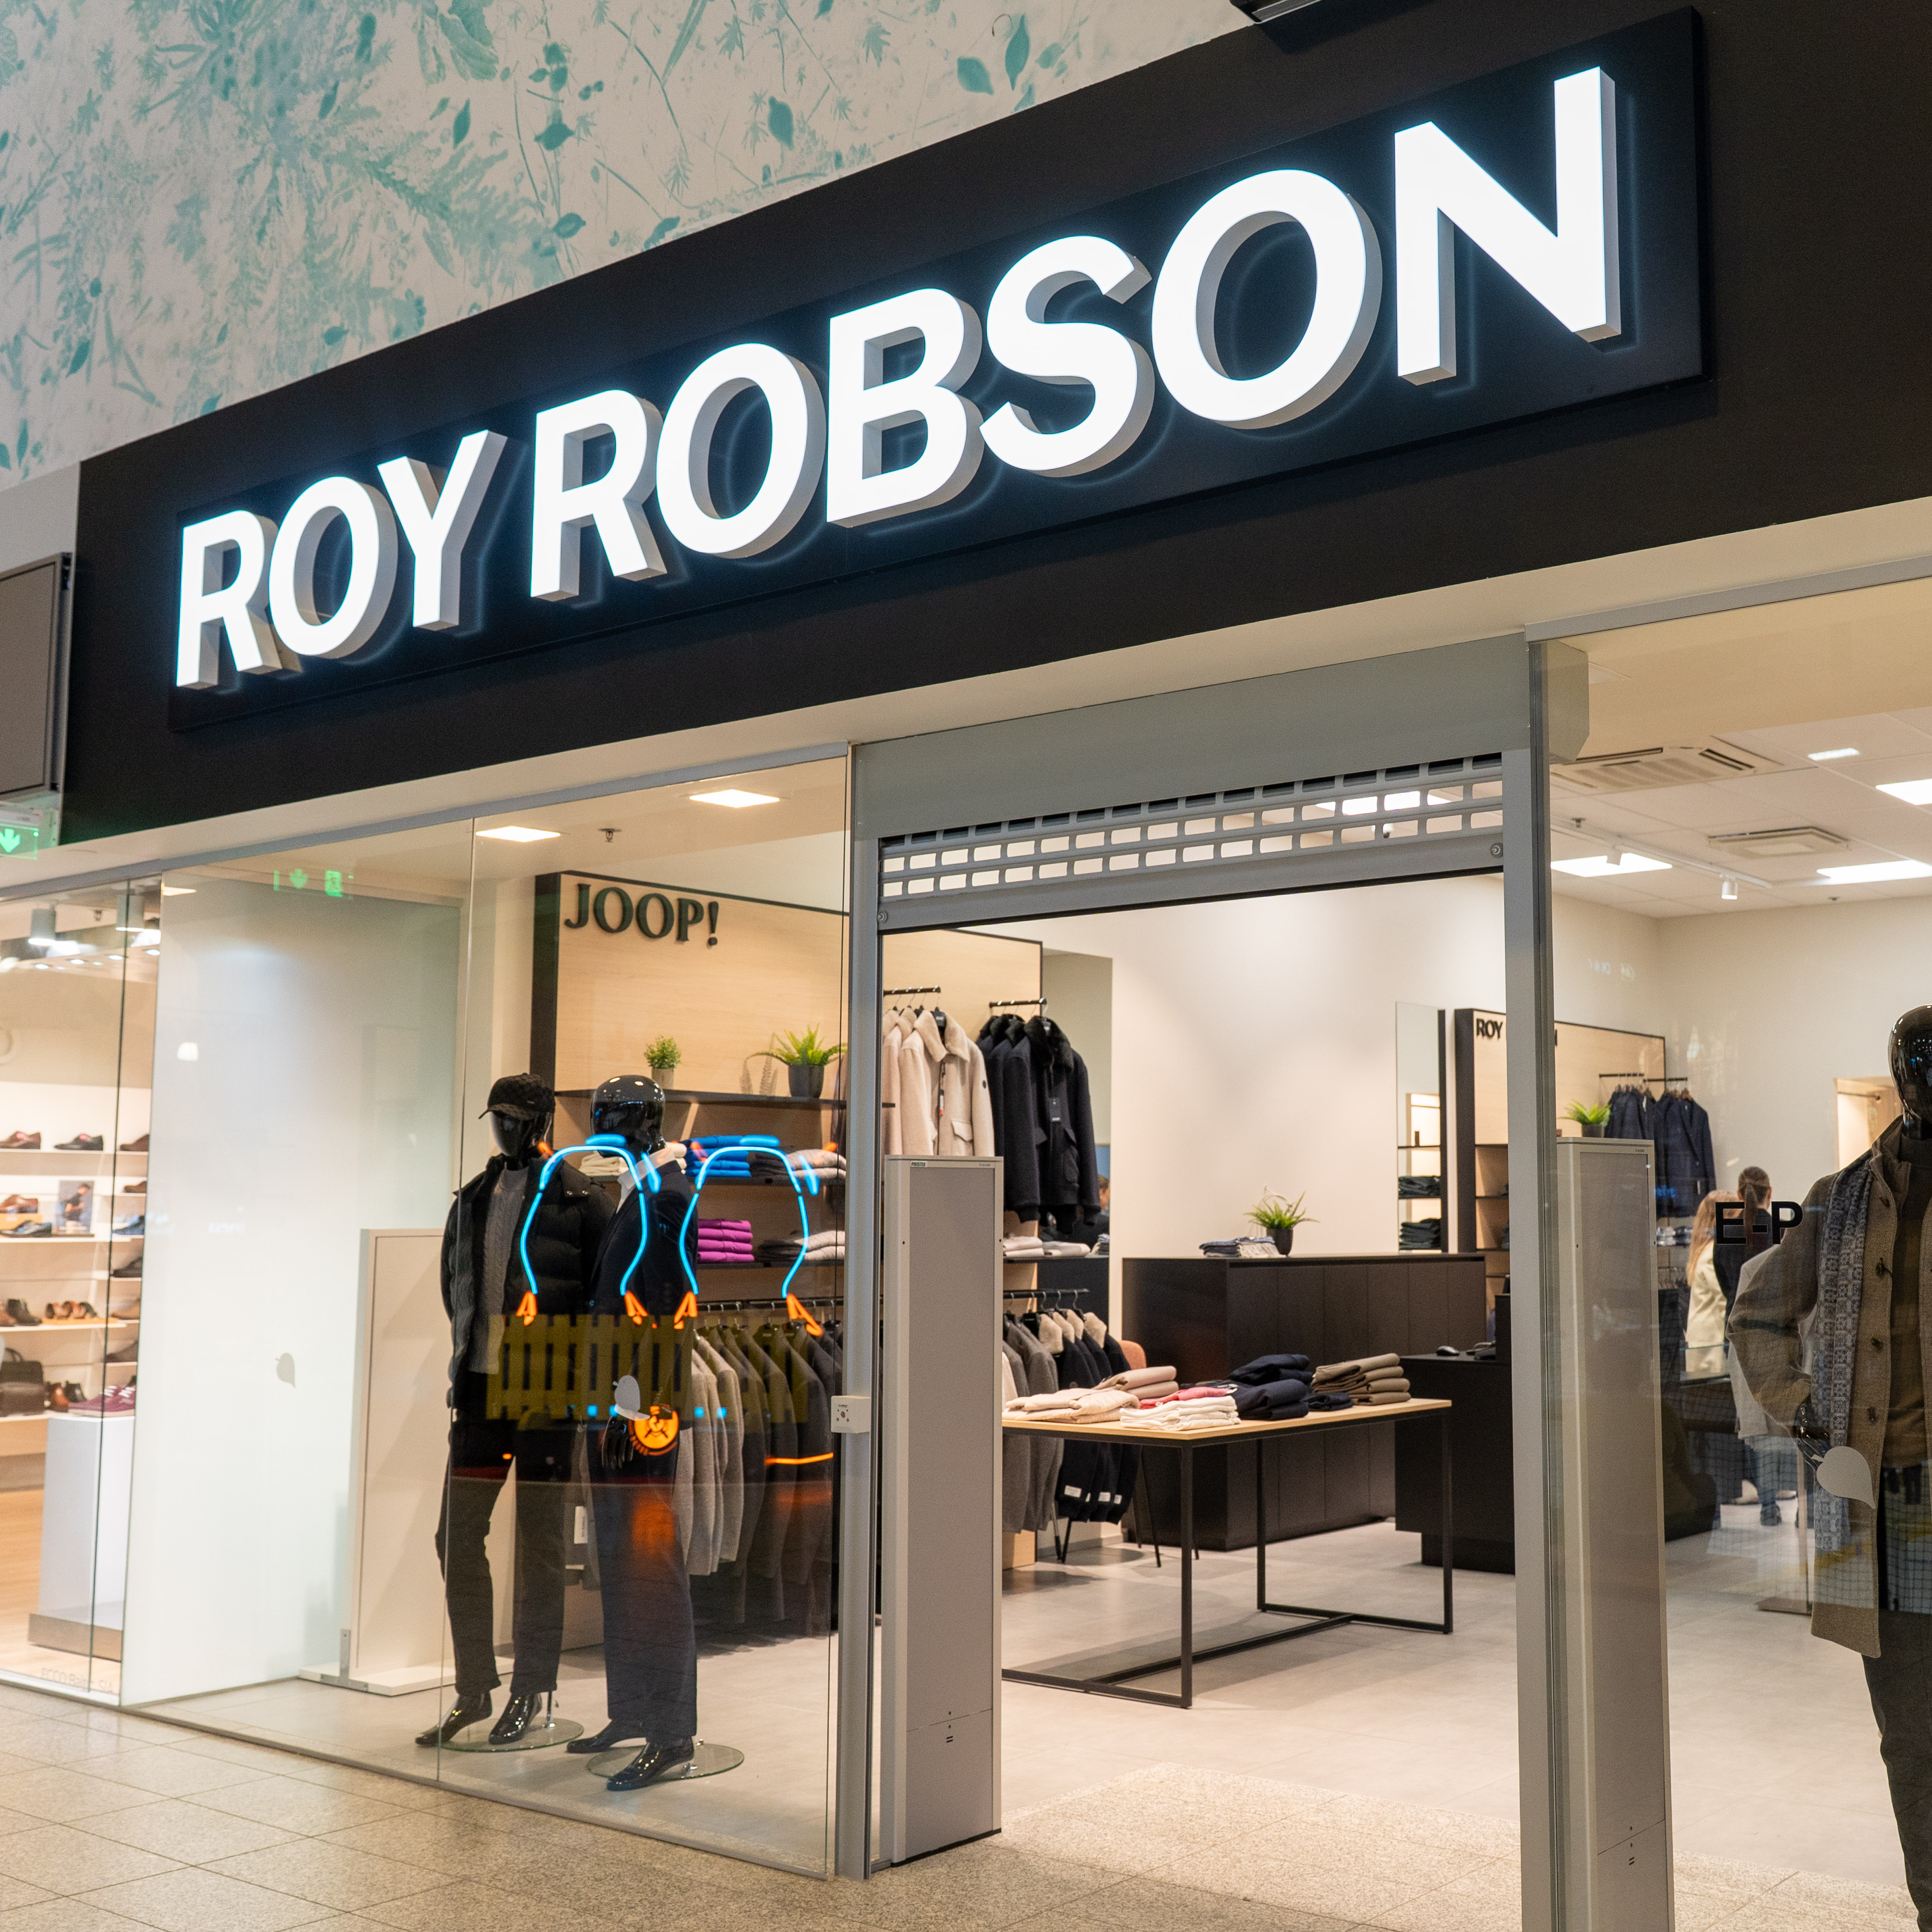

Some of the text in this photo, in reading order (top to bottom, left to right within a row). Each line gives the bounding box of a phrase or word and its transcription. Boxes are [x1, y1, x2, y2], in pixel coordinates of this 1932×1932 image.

[176, 66, 1607, 687] ROY ROBSON
[564, 883, 719, 945] JOOP!
[1476, 1018, 1503, 1039] ROY
[1715, 1201, 1803, 1244] E-P
